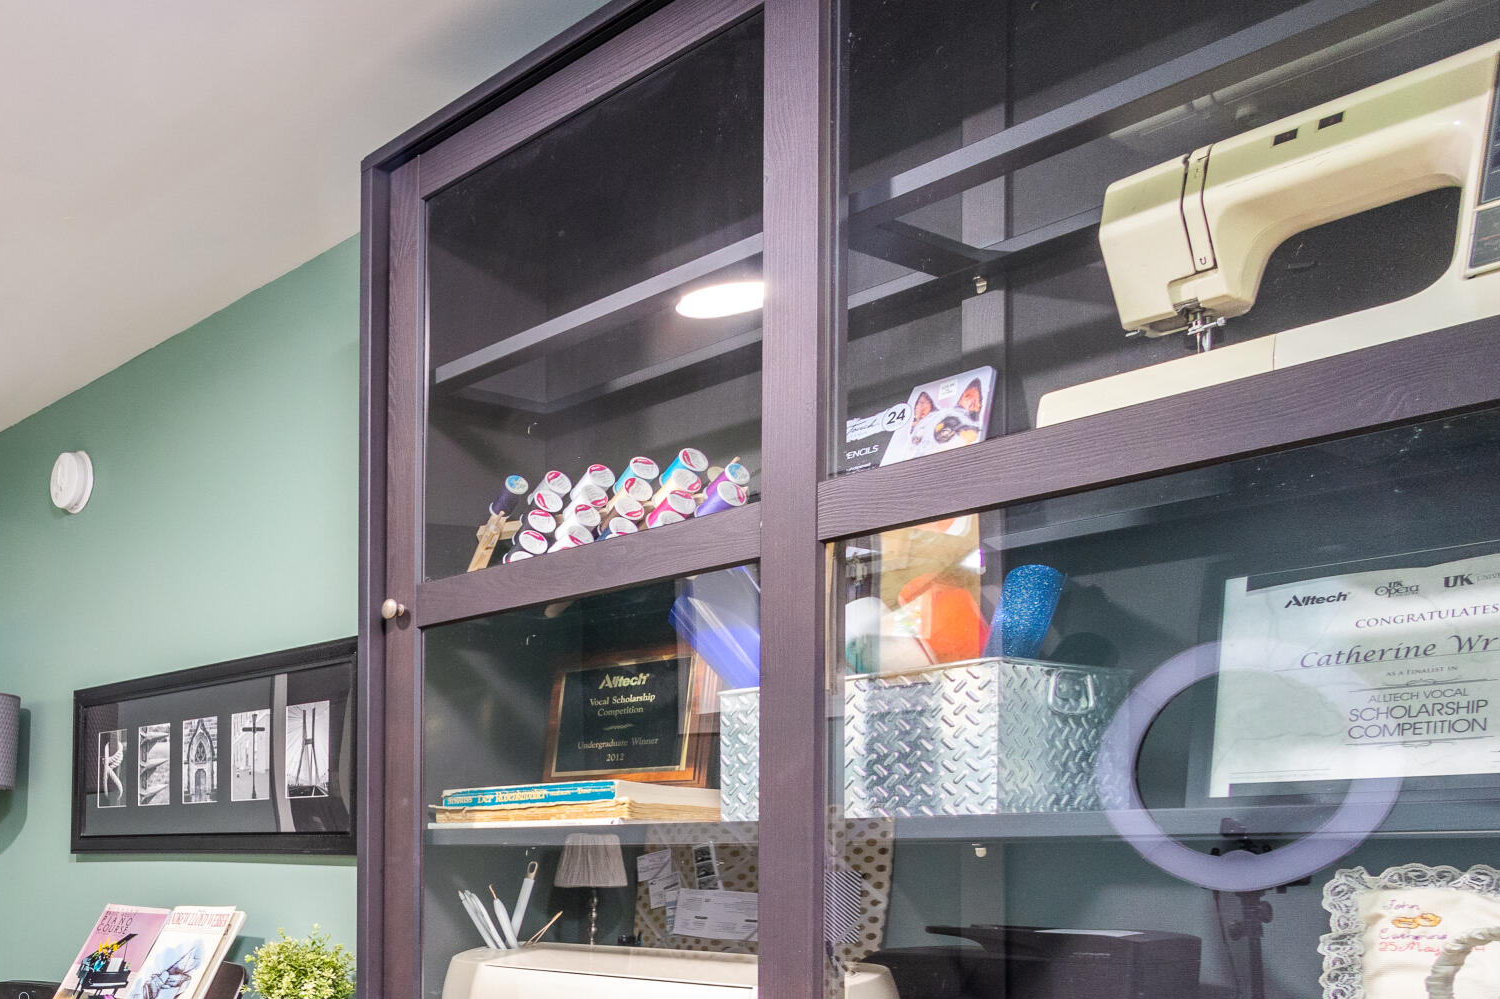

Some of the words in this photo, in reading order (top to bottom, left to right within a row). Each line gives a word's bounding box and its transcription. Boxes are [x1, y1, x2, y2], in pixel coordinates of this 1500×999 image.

[888, 409, 906, 425] 24
[846, 445, 879, 460] ENCILS
[1444, 573, 1474, 588] UK
[1284, 592, 1349, 608] Alltech
[1355, 603, 1500, 629] CONGRATULATES
[1300, 642, 1437, 669] Catherine
[598, 673, 647, 690] Alltech
[589, 696, 610, 706] Vocal
[612, 692, 656, 704] Scholarship
[1368, 690, 1420, 703] ALLTECH
[1423, 688, 1469, 700] VOCAL
[597, 706, 644, 718] Competition
[1349, 699, 1488, 722] SCHOLARSHIP
[1348, 717, 1488, 740] COMPETITION
[577, 739, 629, 750] Undergraduate
[631, 737, 659, 745] Winner
[606, 752, 625, 762] 2012
[101, 915, 133, 926] PIANO
[97, 923, 129, 934] COURSE
